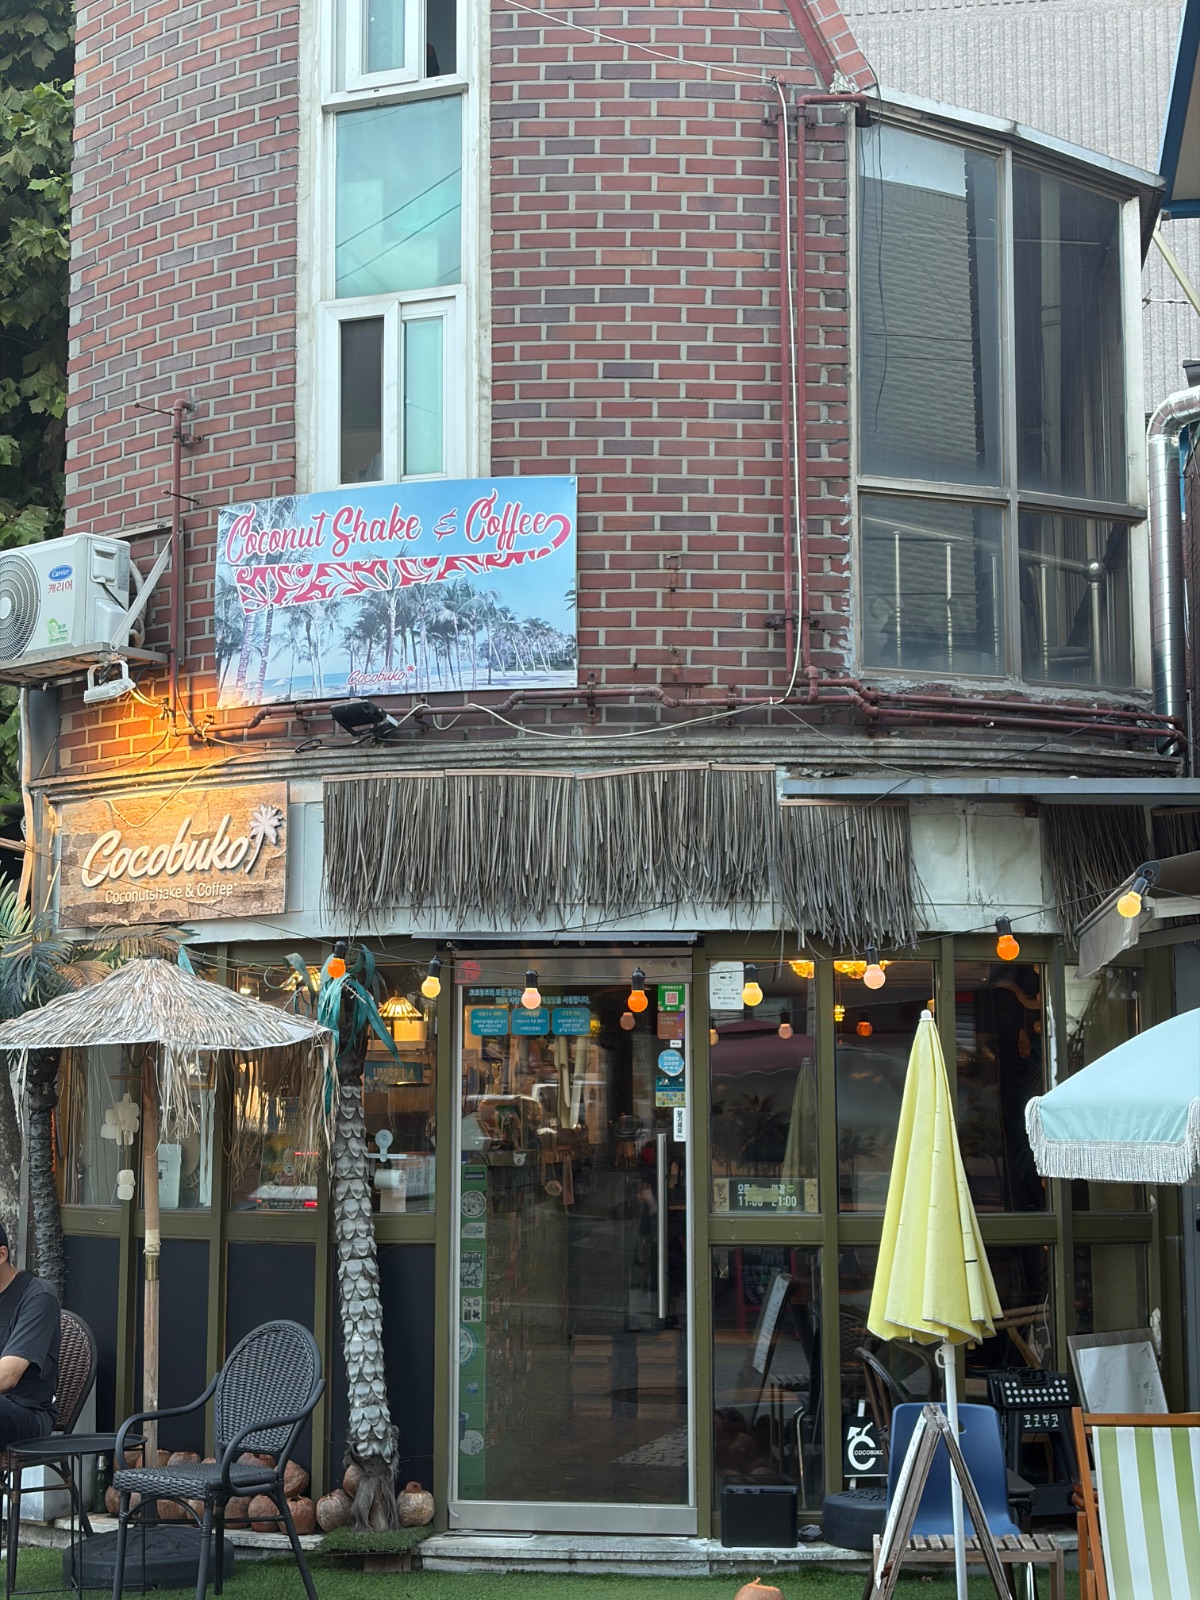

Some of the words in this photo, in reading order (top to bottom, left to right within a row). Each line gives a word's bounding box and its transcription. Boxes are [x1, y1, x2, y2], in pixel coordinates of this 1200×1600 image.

[226, 503, 328, 563] Coconut
[331, 503, 422, 557] Shake
[433, 508, 457, 541] &
[465, 488, 549, 551] Coffee
[51, 568, 70, 578] Carrier
[48, 580, 73, 594] 캐리어
[348, 666, 406, 685] Cocobuko
[81, 813, 250, 887] Cocobuko
[105, 886, 182, 904] Coconutshake
[185, 886, 195, 898] &
[197, 882, 234, 897] Coffee
[1023, 1413, 1059, 1428] 코코부코
